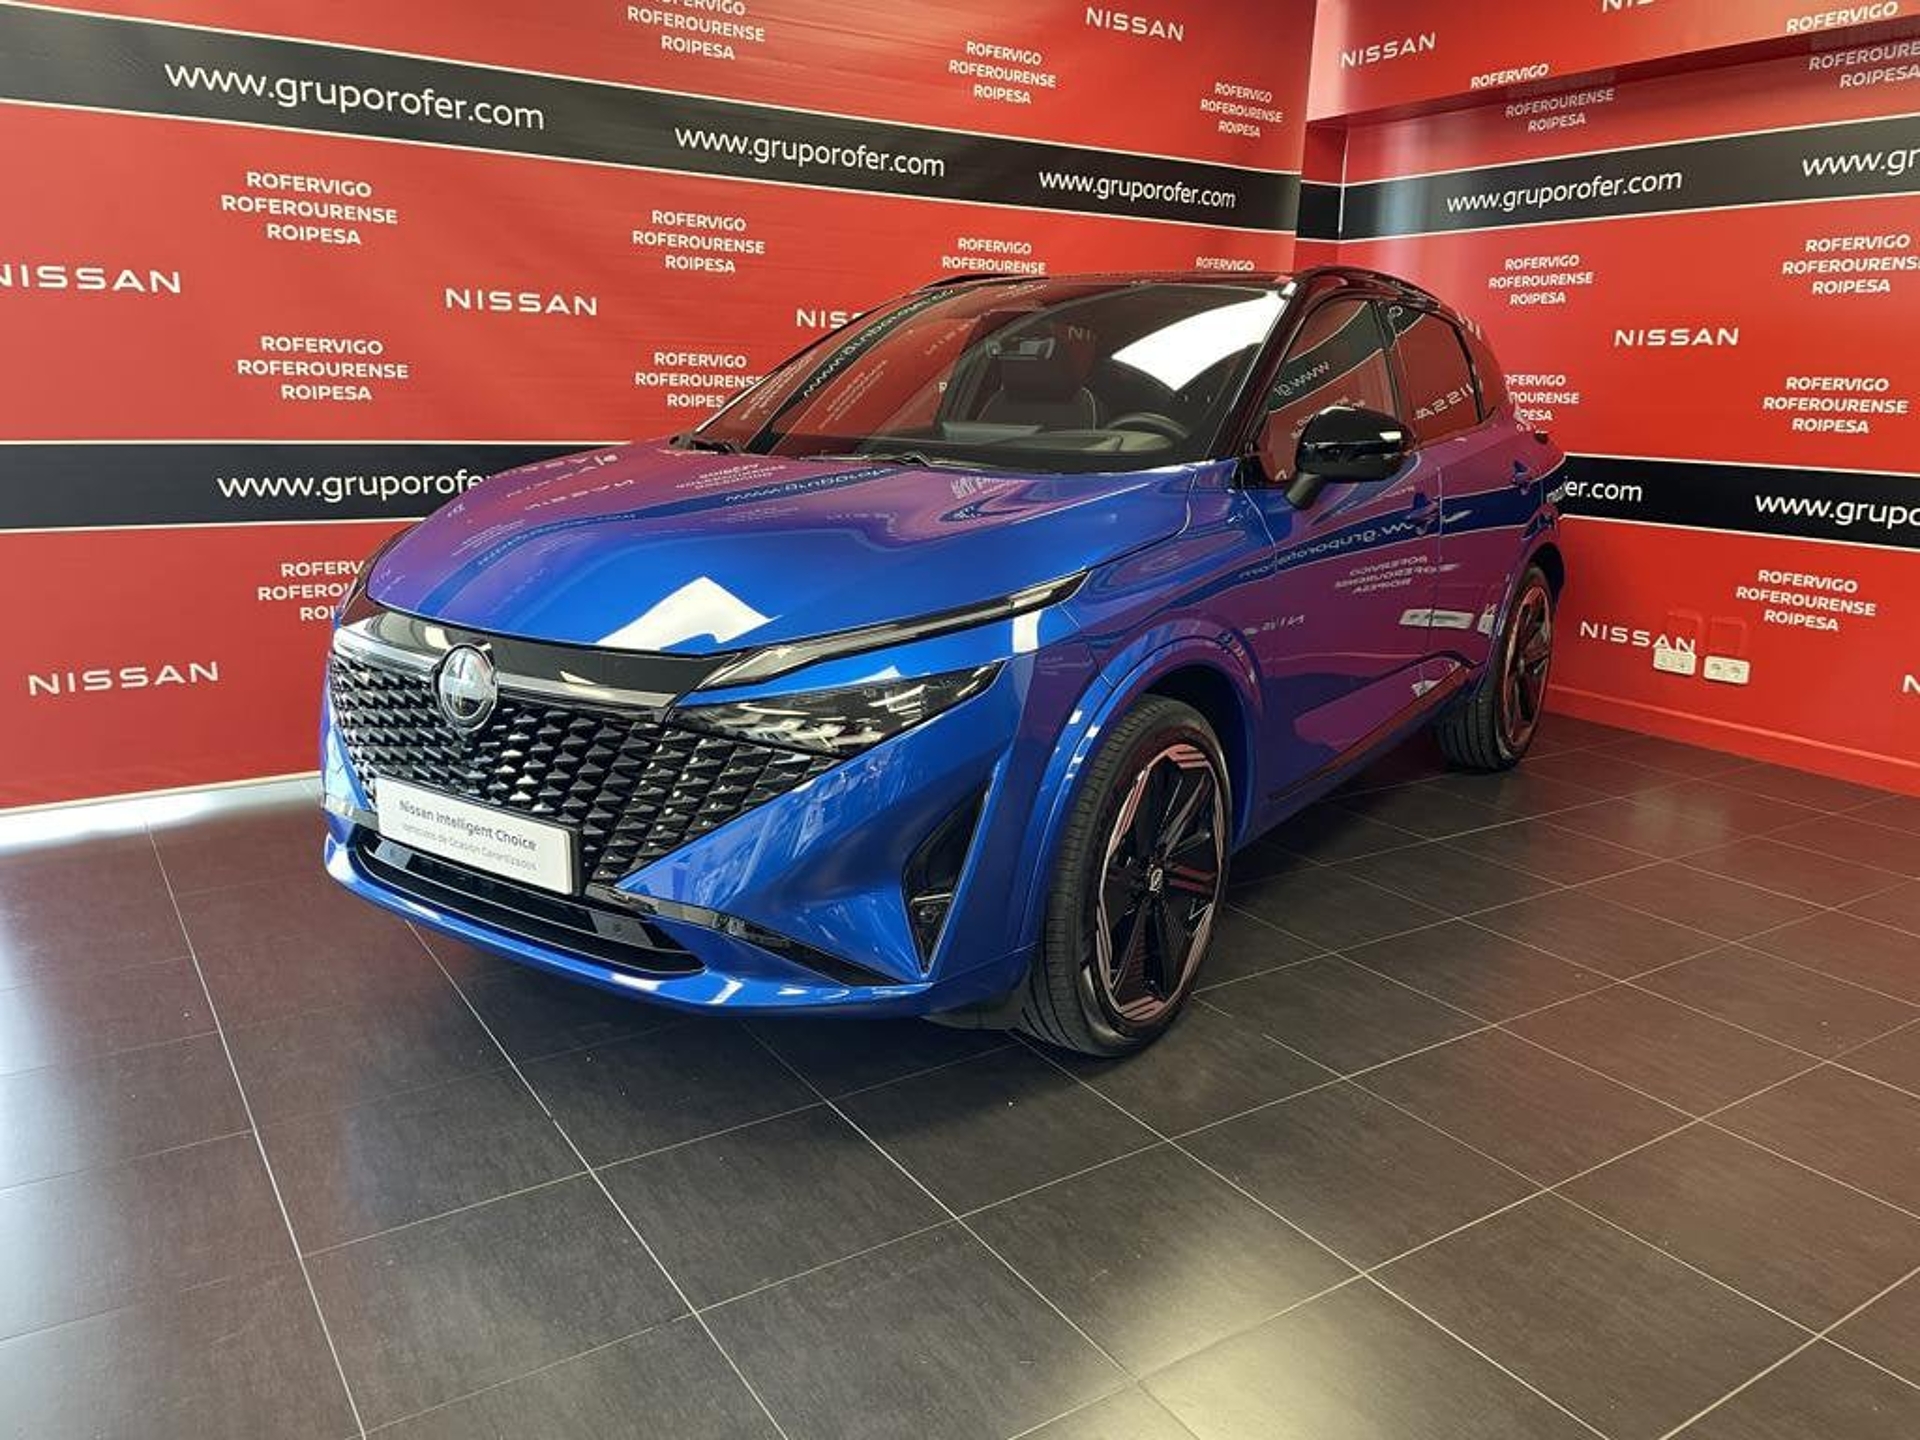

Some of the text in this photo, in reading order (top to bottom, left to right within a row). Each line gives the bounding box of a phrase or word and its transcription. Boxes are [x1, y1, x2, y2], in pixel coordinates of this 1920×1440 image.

[627, 5, 766, 42] ROFEROURENSE
[1085, 6, 1184, 42] NISSAN
[1785, 0, 1900, 34] ROFERVIGO
[660, 34, 736, 61] ROIPESA
[965, 40, 1043, 66] ROFERVIGO
[1338, 31, 1437, 68] NISSAN
[948, 59, 1057, 89] ROFEROURENSE
[1470, 63, 1550, 89] ROFERVIGO
[164, 63, 544, 130] www.gruporofer.com
[973, 83, 1032, 104] ROIPESA
[1214, 81, 1273, 104] ROFERVIGO
[1505, 87, 1615, 119] ROFEROURENSE
[1218, 119, 1261, 138] ROIPESA
[1527, 111, 1587, 132] ROIPESA
[674, 127, 945, 177] www.gruporofer.com
[246, 171, 372, 198] ROFERVIGO
[1038, 171, 1236, 209] www.gruporofer.com
[1447, 171, 1683, 213] www.gruporofer.com
[220, 194, 398, 225] ROFEROURENSE
[651, 209, 747, 232] ROFERVIGO
[266, 222, 362, 245] ROIPESA
[632, 230, 766, 255] ROFEROURENSE
[1805, 233, 1911, 253] ROFERVIGO
[957, 237, 1032, 256] ROFERVIGO
[664, 254, 736, 273] ROIPESA
[941, 255, 1047, 277] ROFEROURENSE
[1194, 255, 1256, 272] ROFERVIGO
[1504, 254, 1580, 272] ROFERVIGO
[1781, 255, 1920, 275] ROFEROURENS
[1488, 271, 1594, 290] ROFEROURENSE
[1811, 278, 1891, 295] ROIPESA
[445, 287, 597, 316] NISSAN
[1509, 291, 1566, 306] ROIPESA
[795, 307, 866, 330] NIS
[260, 335, 384, 356] ROFERVIGO
[1614, 327, 1739, 347] NISSAN
[237, 359, 409, 379] ROFEROURENSE
[653, 351, 748, 369] ROFERVIGO
[280, 384, 373, 401] ROIPESA
[1785, 376, 1890, 393] ROFERVIGO
[1762, 396, 1910, 415] ROFEROURENSE
[1791, 417, 1869, 434] ROIPESA
[216, 468, 491, 502] www.gruporofe
[1563, 478, 1643, 503] er.com
[1757, 569, 1859, 594] ROFERVIGO
[1735, 586, 1877, 617] ROFEROURENSE
[1763, 608, 1839, 632] ROIPESA
[1579, 620, 1696, 654] NISSAN
[28, 661, 219, 696] NISSAN
[435, 811, 494, 839] Intelligent
[495, 829, 538, 851] Choice
